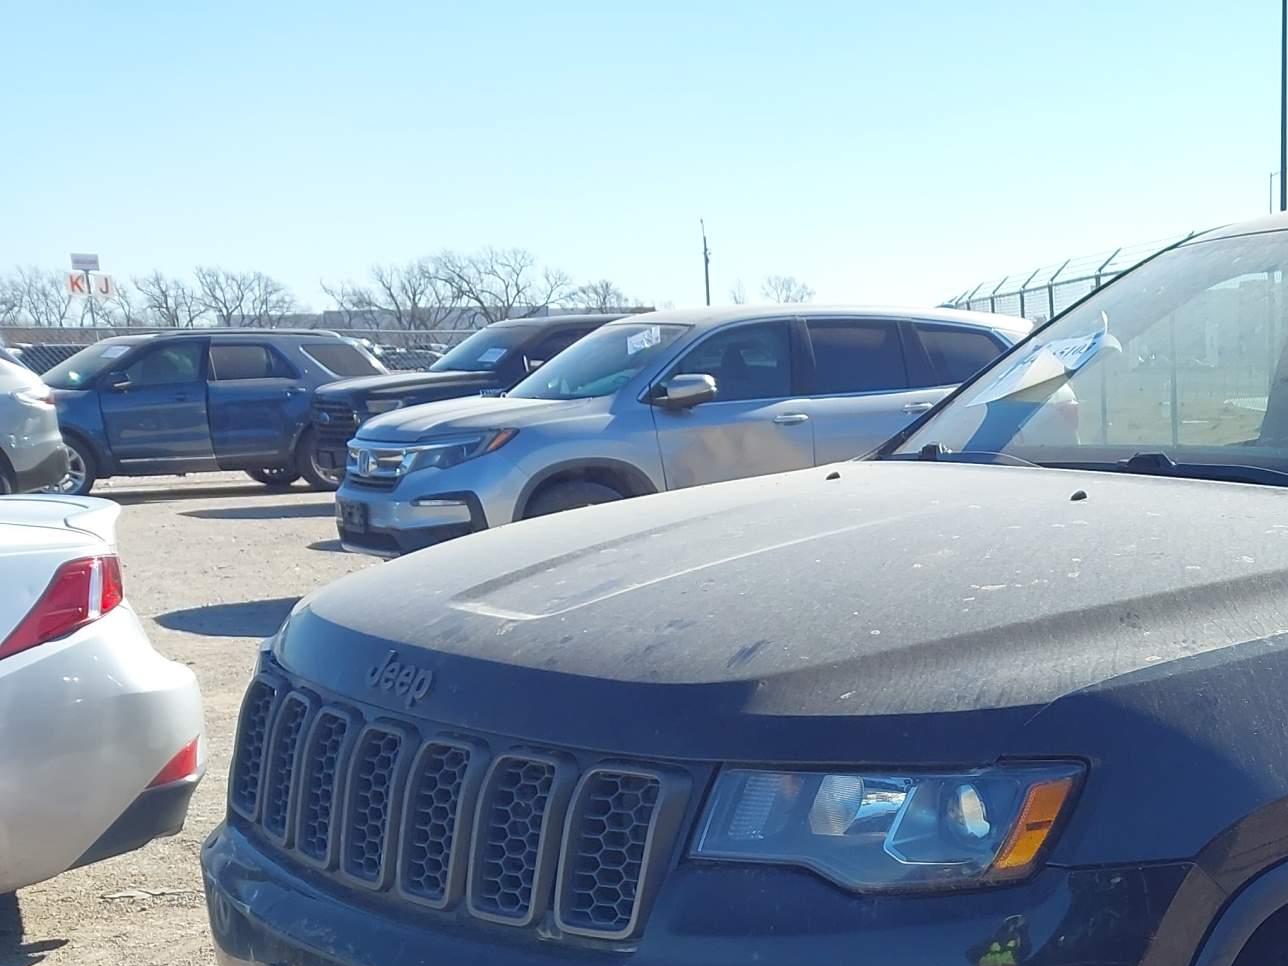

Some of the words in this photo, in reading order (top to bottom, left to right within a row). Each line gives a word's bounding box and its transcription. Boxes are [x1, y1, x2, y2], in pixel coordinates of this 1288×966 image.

[70, 274, 84, 293] K
[99, 277, 109, 294] J
[364, 648, 433, 710] Jeep
